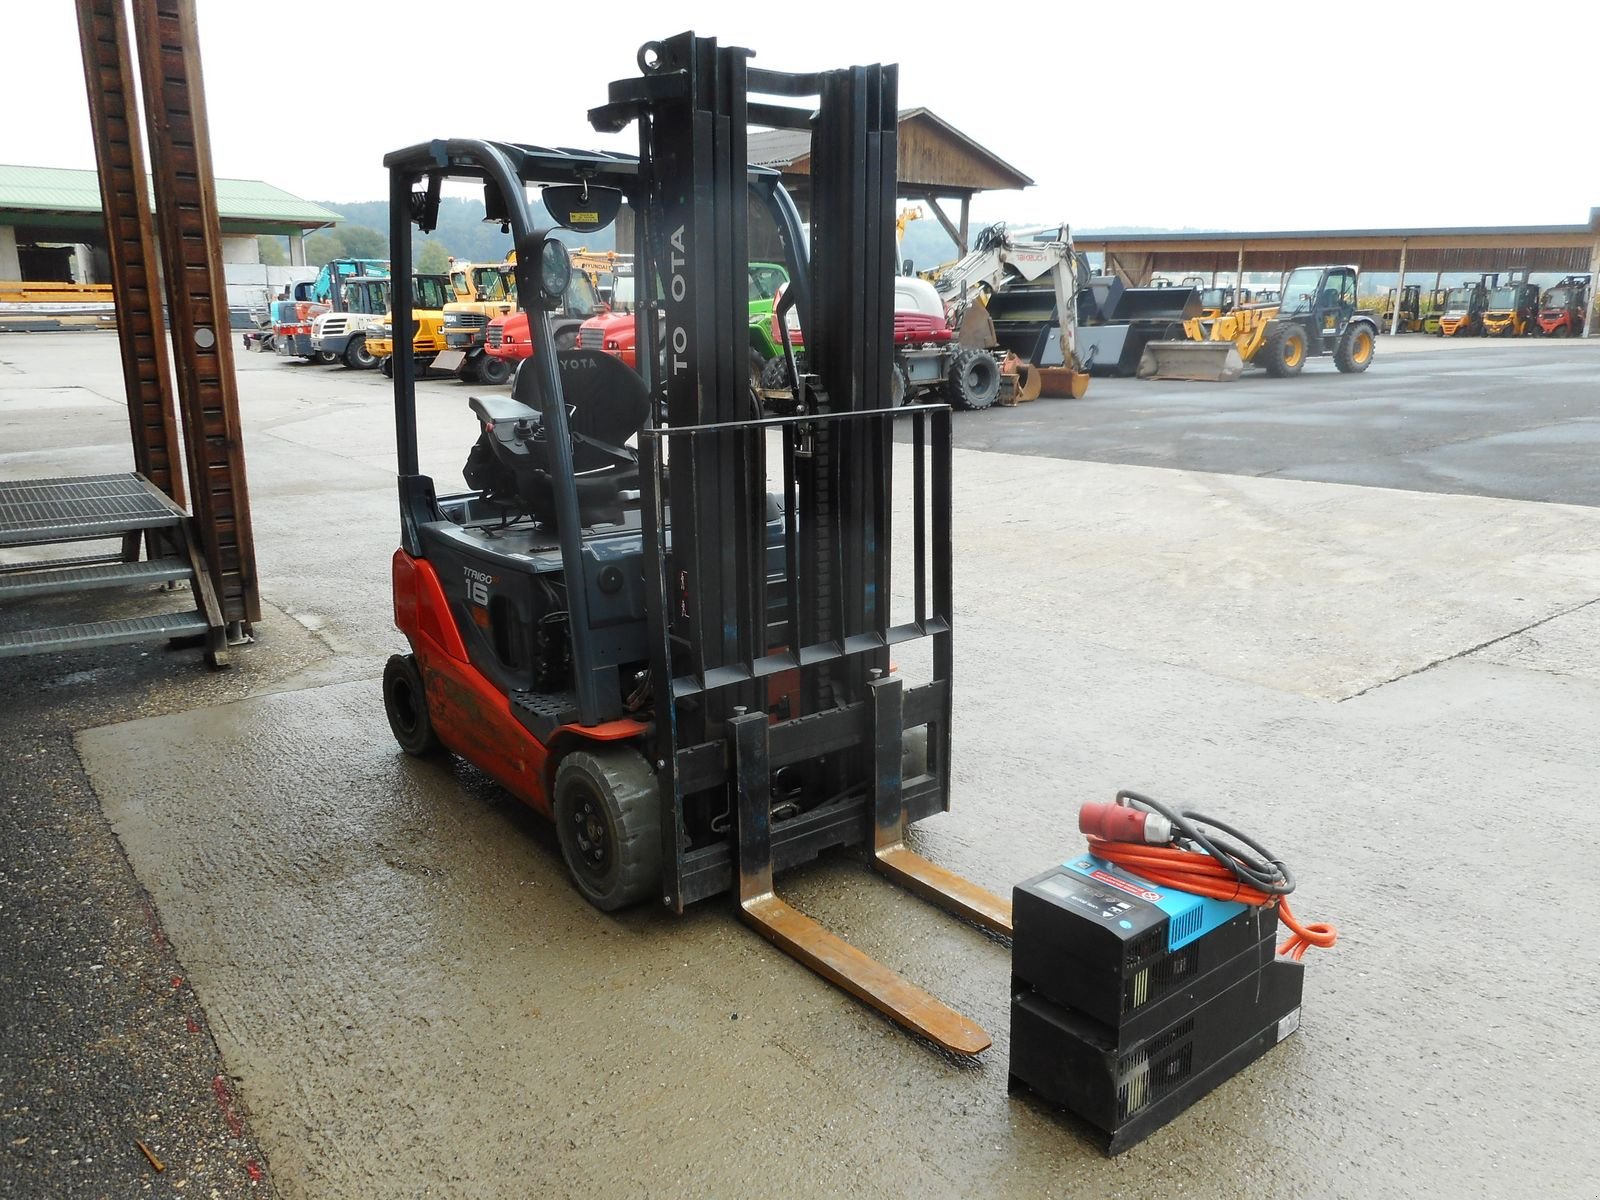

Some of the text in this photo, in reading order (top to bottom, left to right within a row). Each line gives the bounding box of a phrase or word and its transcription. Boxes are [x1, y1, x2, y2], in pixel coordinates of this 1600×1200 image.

[671, 224, 688, 375] TOOTA
[560, 358, 597, 370] YOTA
[465, 578, 489, 605] 16
